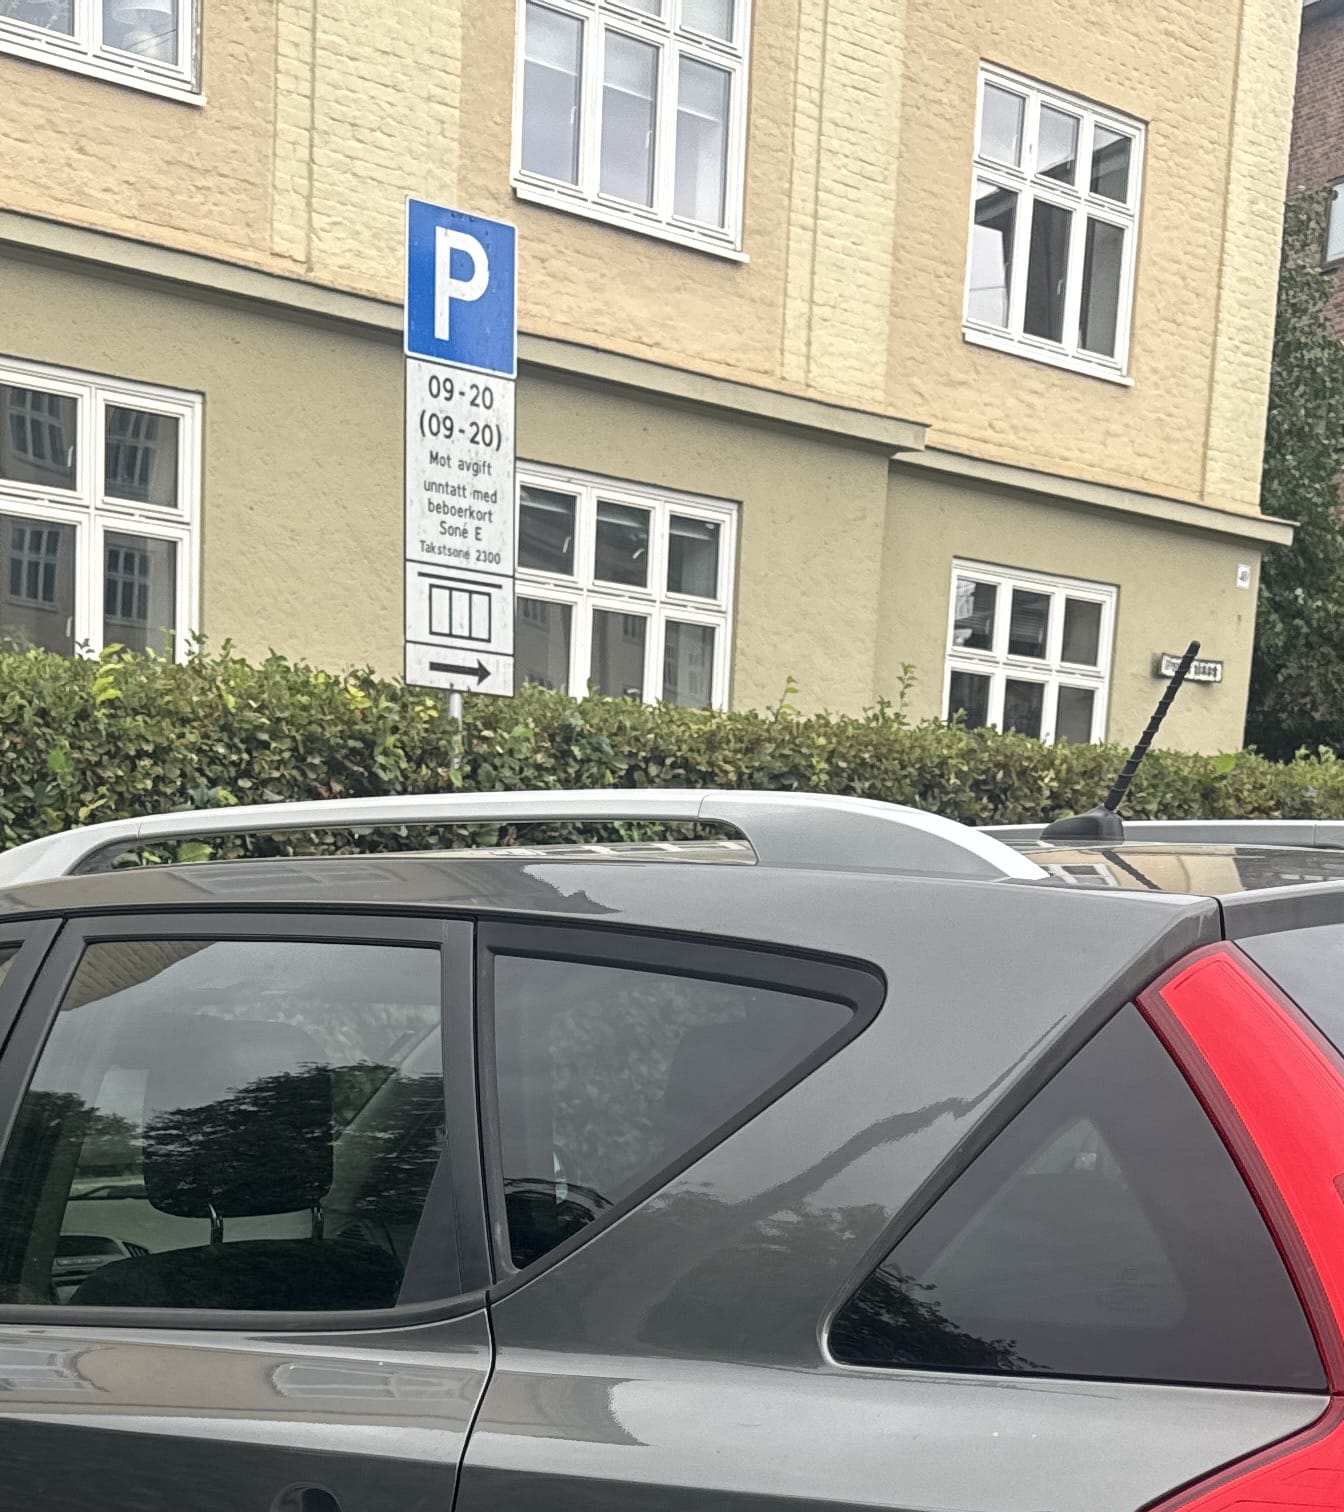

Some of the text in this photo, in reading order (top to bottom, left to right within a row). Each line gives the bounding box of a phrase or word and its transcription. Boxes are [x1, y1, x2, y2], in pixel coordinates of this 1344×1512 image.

[434, 225, 490, 342] P
[428, 374, 494, 410] 09-20
[419, 409, 502, 452] (09-20)
[429, 449, 493, 477] Mot avgift
[423, 479, 498, 505] unntatt med
[427, 497, 493, 524] beboerkort
[474, 525, 483, 542] E
[419, 539, 501, 566] Takstsone 2300
